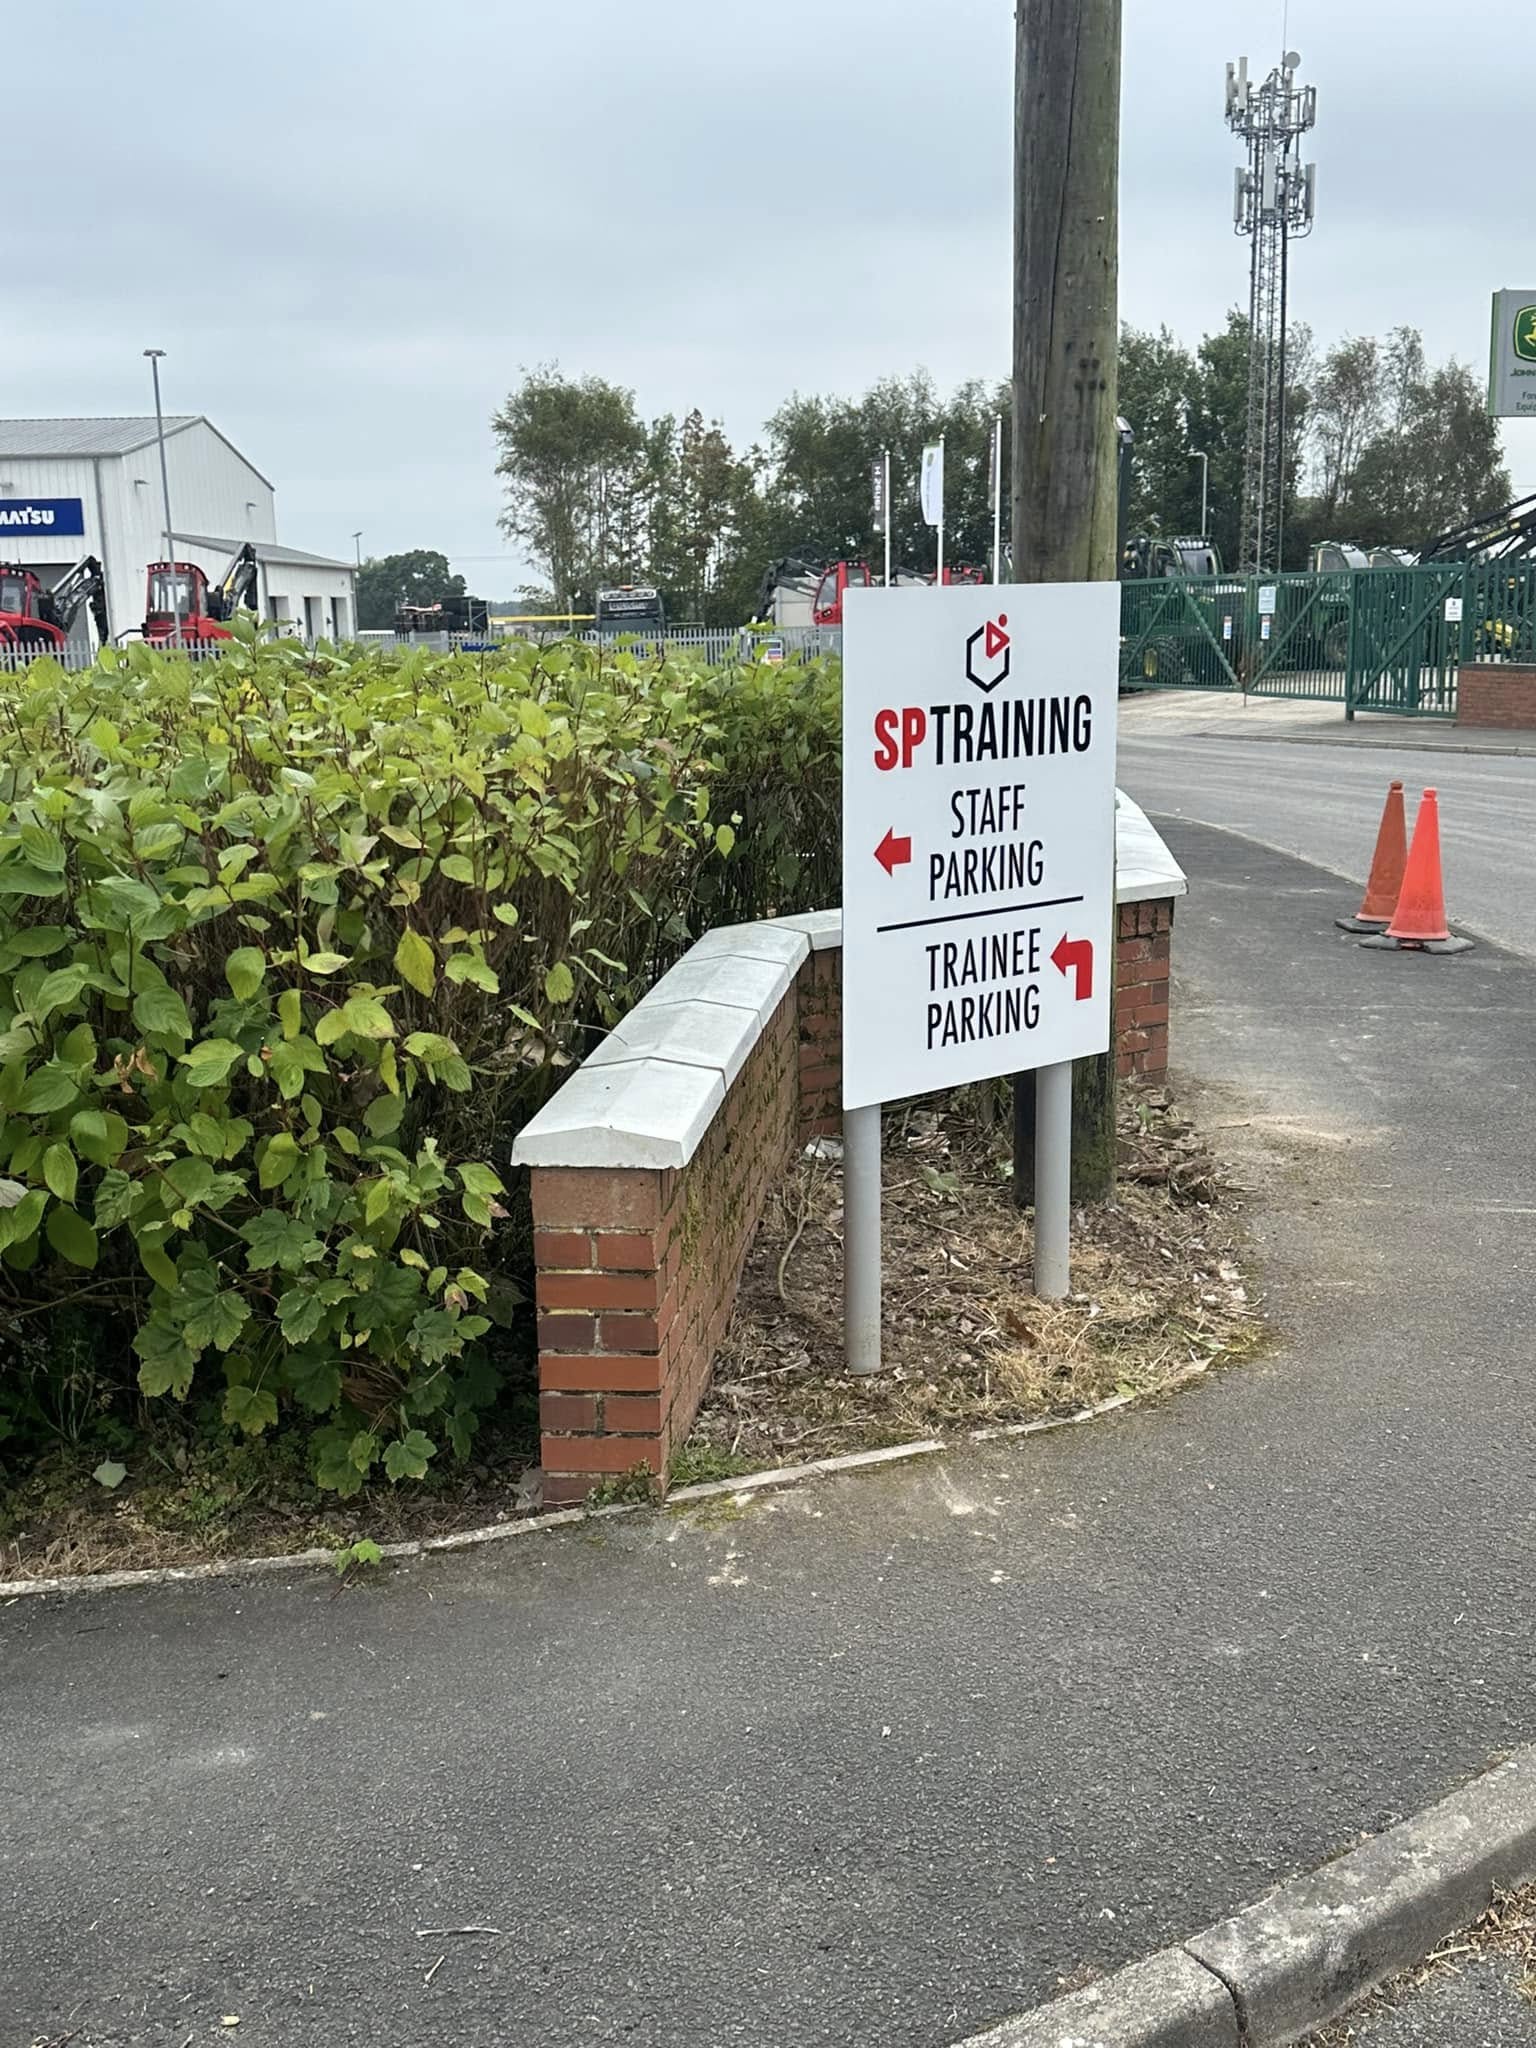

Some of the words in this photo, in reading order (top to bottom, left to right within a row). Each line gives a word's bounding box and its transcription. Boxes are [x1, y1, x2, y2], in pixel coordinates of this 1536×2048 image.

[951, 784, 1027, 839] STAFF
[929, 839, 1045, 901] PARKING
[925, 927, 1041, 992] TRAINEE
[927, 984, 1040, 1050] PARKING
